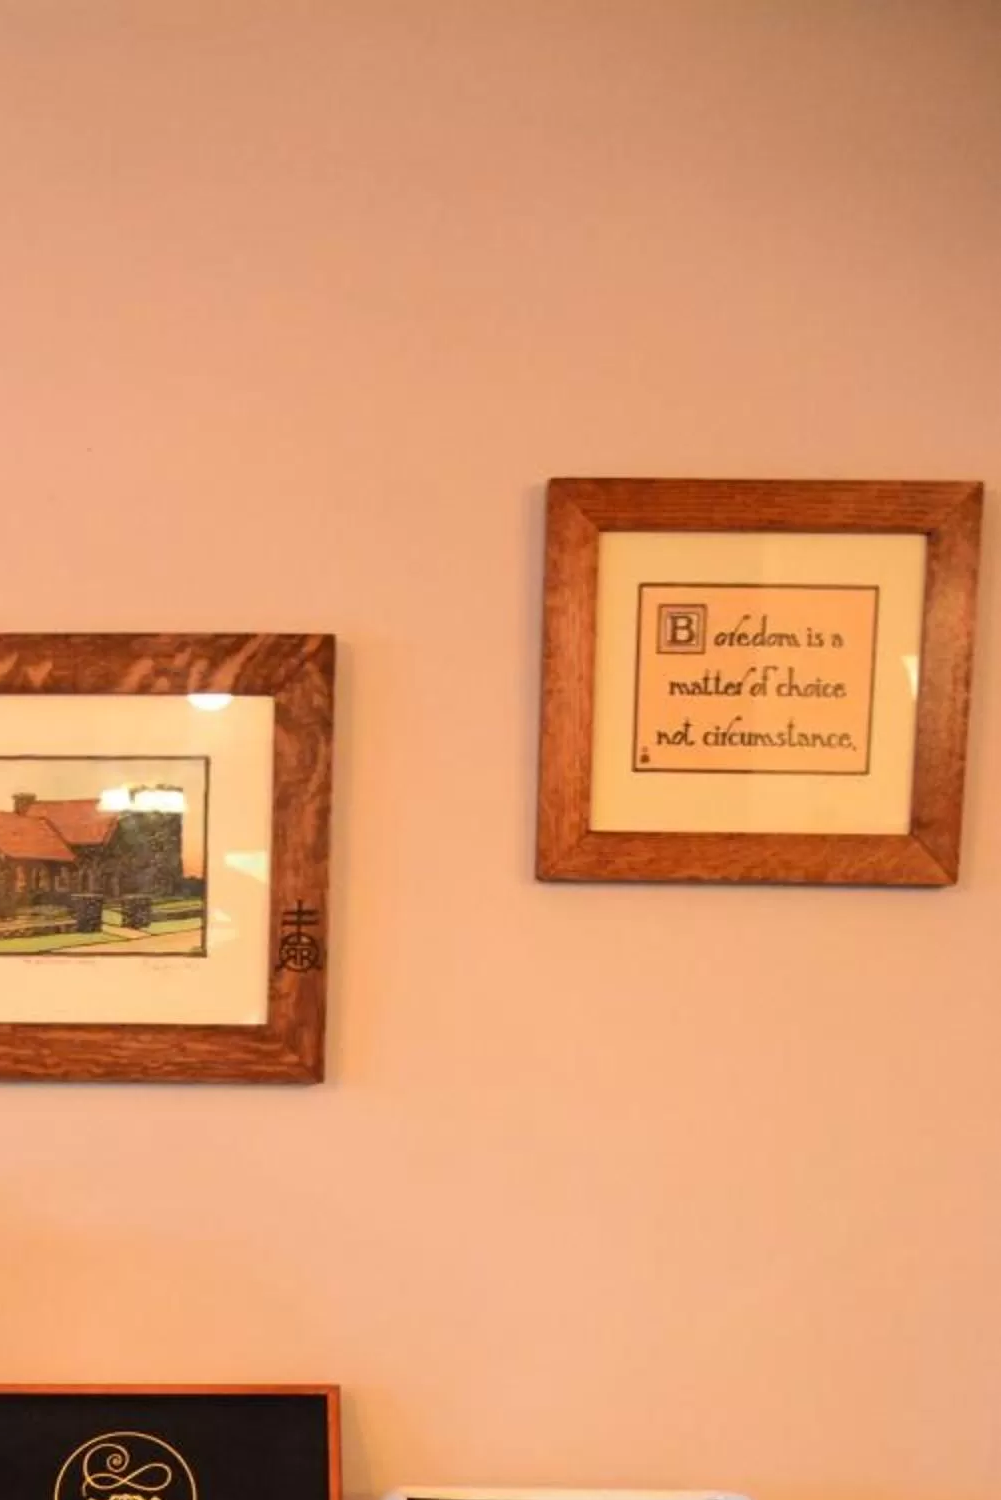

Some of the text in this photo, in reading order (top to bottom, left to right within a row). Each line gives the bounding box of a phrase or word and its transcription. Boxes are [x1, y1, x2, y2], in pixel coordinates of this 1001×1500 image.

[806, 627, 825, 648] is
[831, 633, 844, 648] a
[668, 665, 847, 698] matter of choice
[656, 718, 696, 747] not
